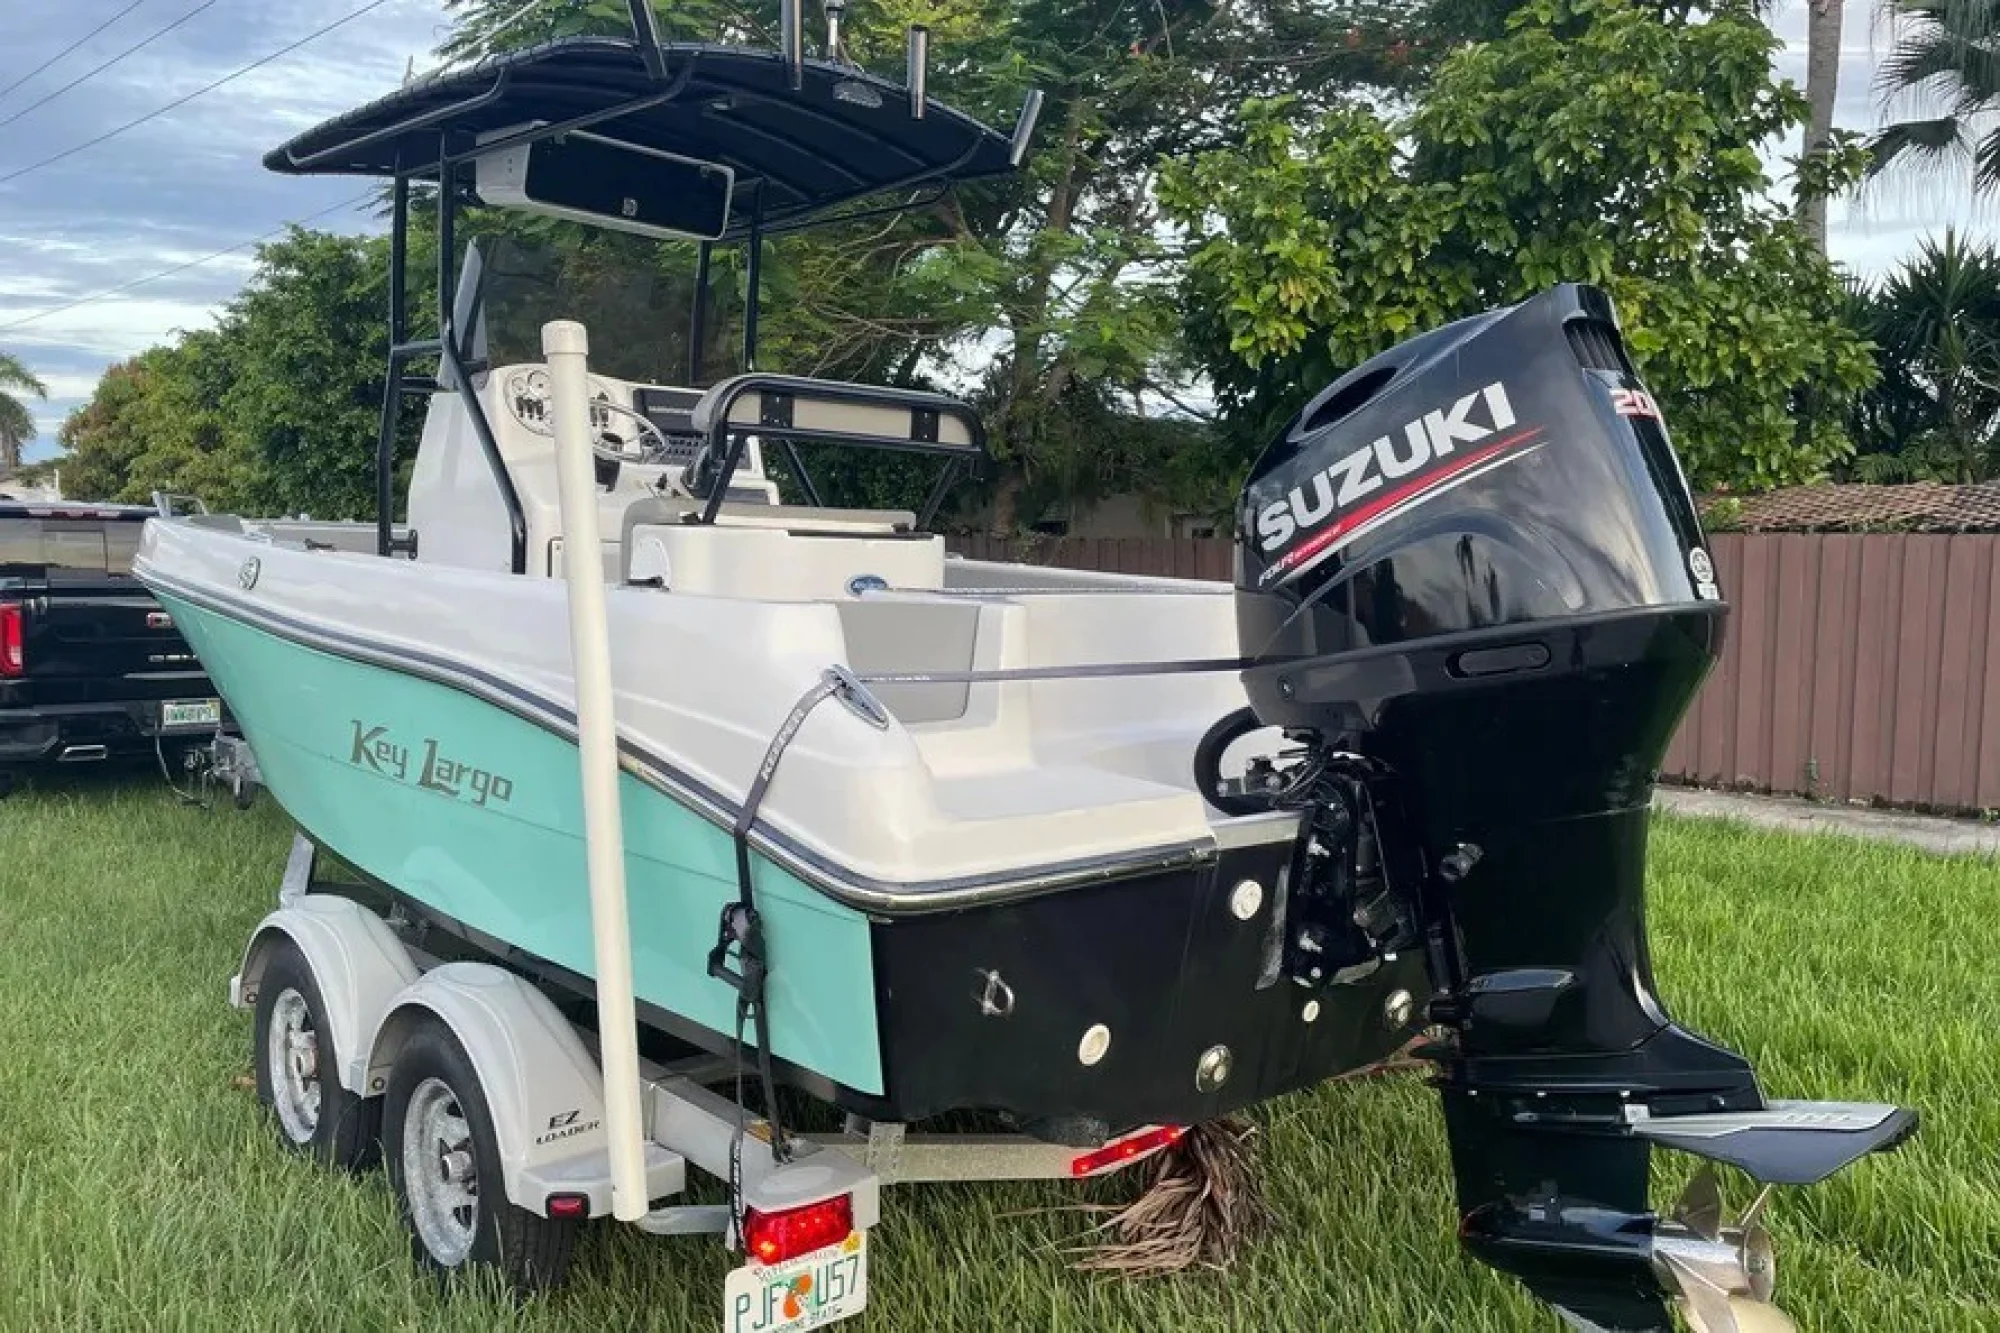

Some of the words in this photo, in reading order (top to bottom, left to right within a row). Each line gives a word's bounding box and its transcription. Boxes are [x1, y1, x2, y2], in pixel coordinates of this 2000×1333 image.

[1608, 387, 1657, 415] 20
[1257, 380, 1517, 551] SUZUKI
[350, 719, 407, 779] Key
[417, 738, 513, 806] Largo
[548, 1108, 580, 1130] EZ
